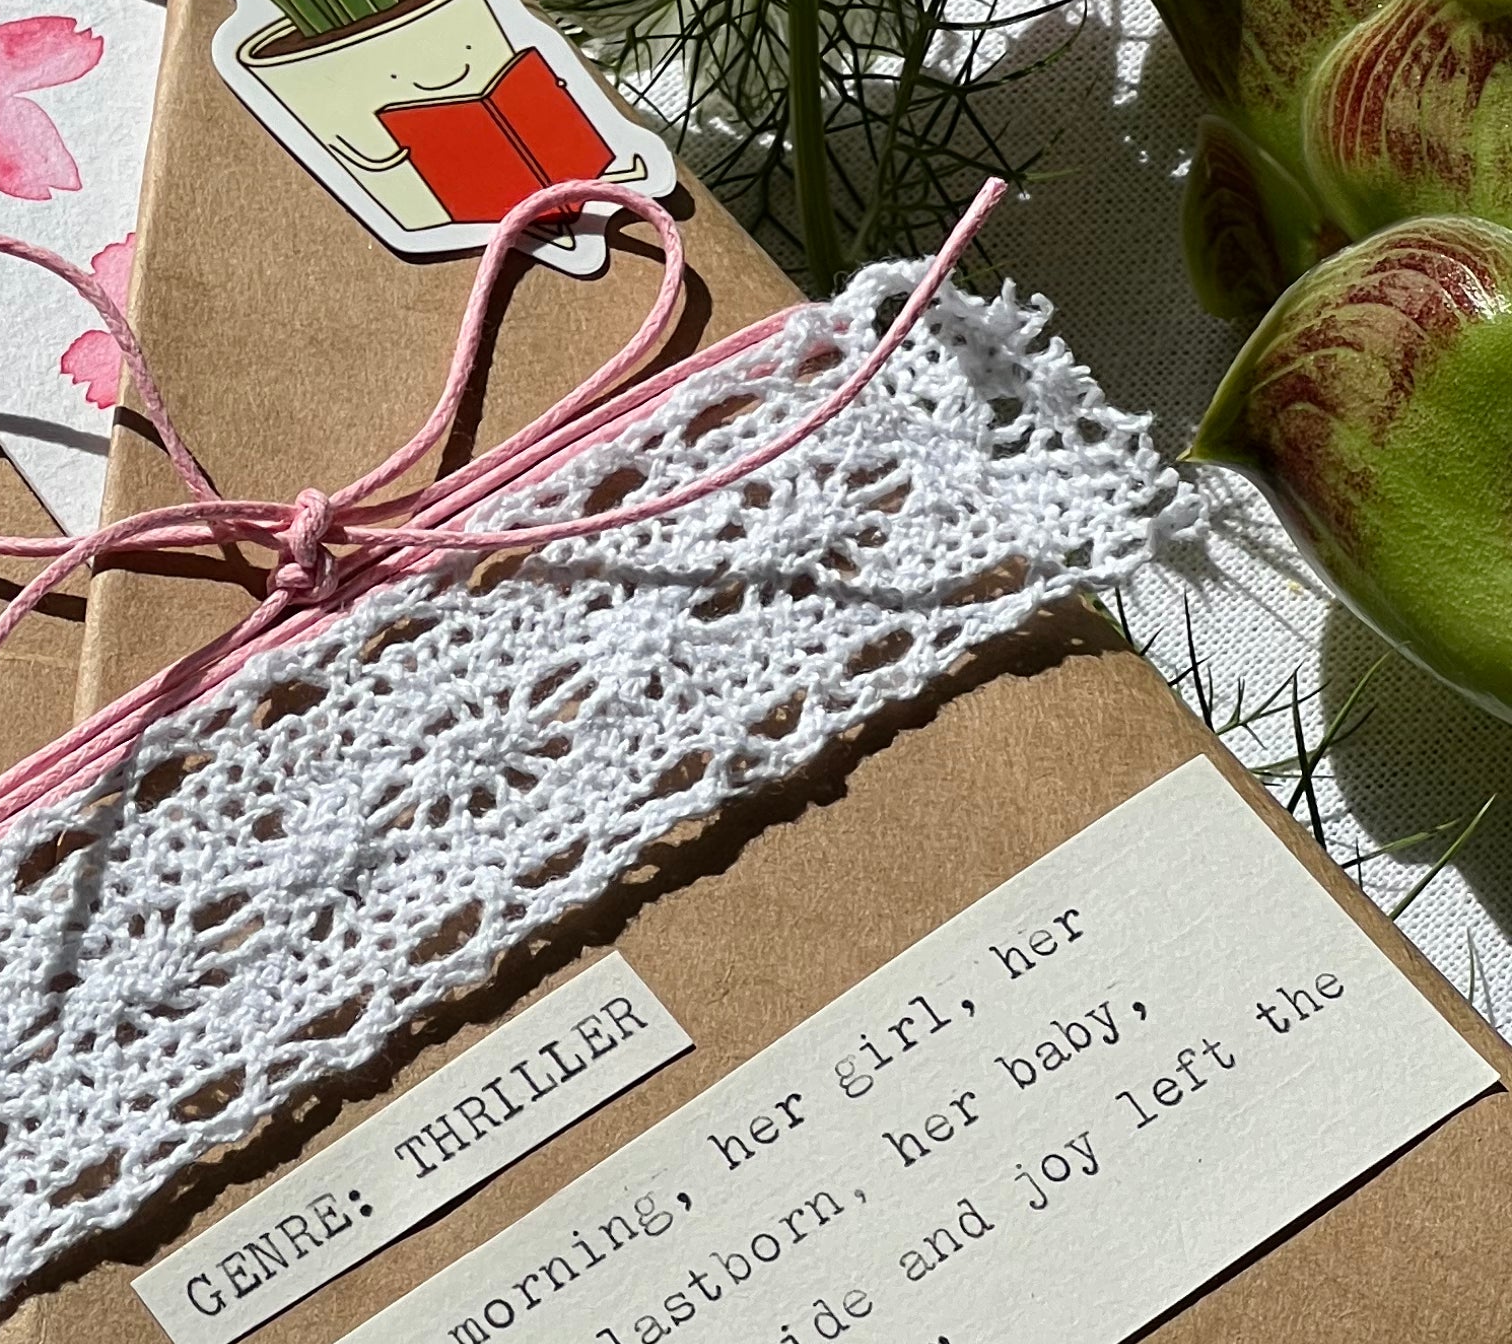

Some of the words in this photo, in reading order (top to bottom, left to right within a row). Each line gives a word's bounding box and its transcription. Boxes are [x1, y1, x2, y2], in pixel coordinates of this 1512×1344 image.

[186, 1189, 374, 1318] GENRE:
[394, 996, 649, 1178] THRILLER
[706, 1092, 805, 1171] her
[834, 995, 976, 1099] girl,
[988, 908, 1084, 980] her
[881, 1089, 979, 1168] her
[993, 993, 1148, 1090] baby,
[899, 1197, 996, 1282] and
[1014, 1130, 1100, 1211] joy
[1114, 1038, 1237, 1130] left
[1255, 972, 1345, 1035] the
